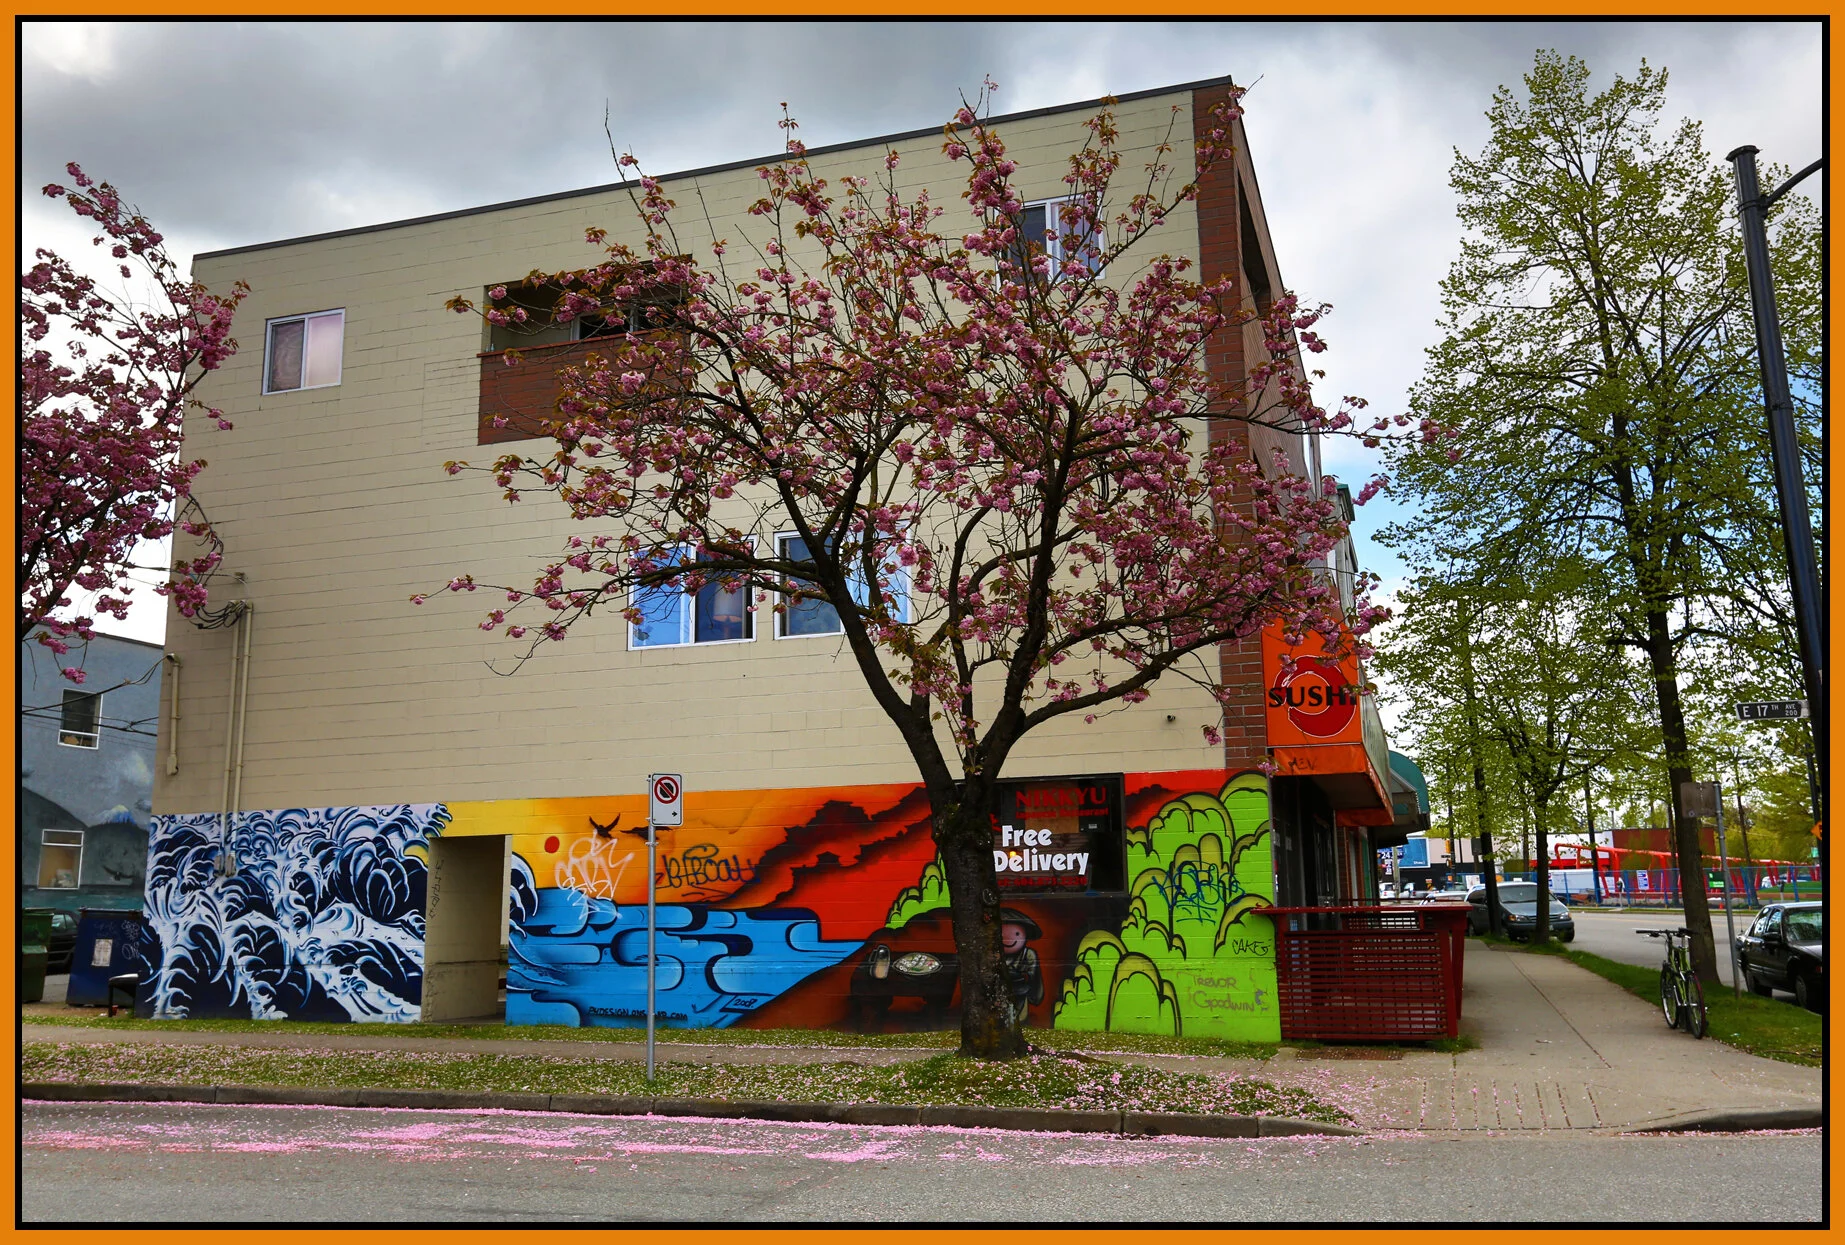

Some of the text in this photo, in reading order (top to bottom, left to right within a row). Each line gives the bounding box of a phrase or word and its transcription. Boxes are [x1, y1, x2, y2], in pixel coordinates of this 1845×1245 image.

[1742, 705, 1751, 718] E
[1015, 786, 1107, 808] NIKKYU
[1001, 825, 1053, 848] Free
[992, 847, 1089, 875] Delivery
